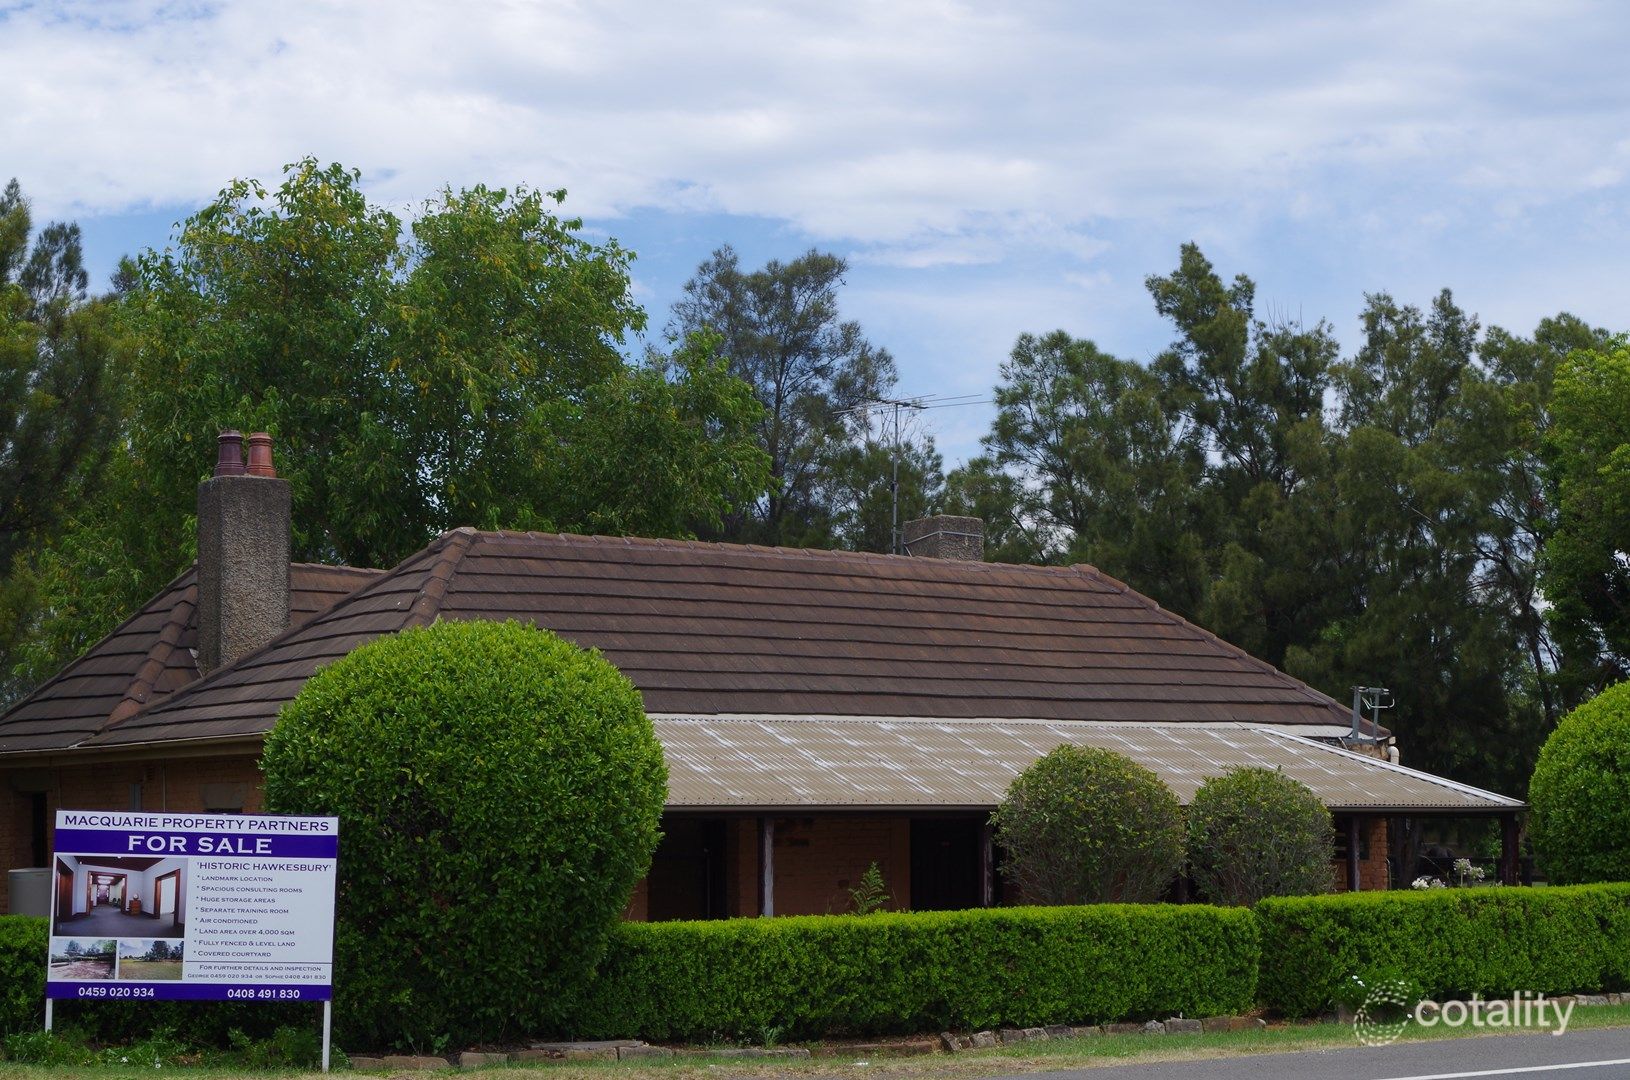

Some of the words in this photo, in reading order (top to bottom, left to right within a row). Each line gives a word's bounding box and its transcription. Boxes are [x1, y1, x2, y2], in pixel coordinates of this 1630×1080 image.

[64, 815, 159, 828] MACQUARIE
[162, 817, 244, 830] PROPERTY
[248, 820, 329, 831] PARTNERS
[127, 835, 187, 852] FOR
[197, 837, 273, 854] SALE
[78, 986, 107, 997] 0459
[109, 987, 131, 997] 020
[133, 988, 155, 997] 934
[227, 988, 255, 998] 0408
[257, 989, 276, 999] 491
[279, 989, 300, 999] 830
